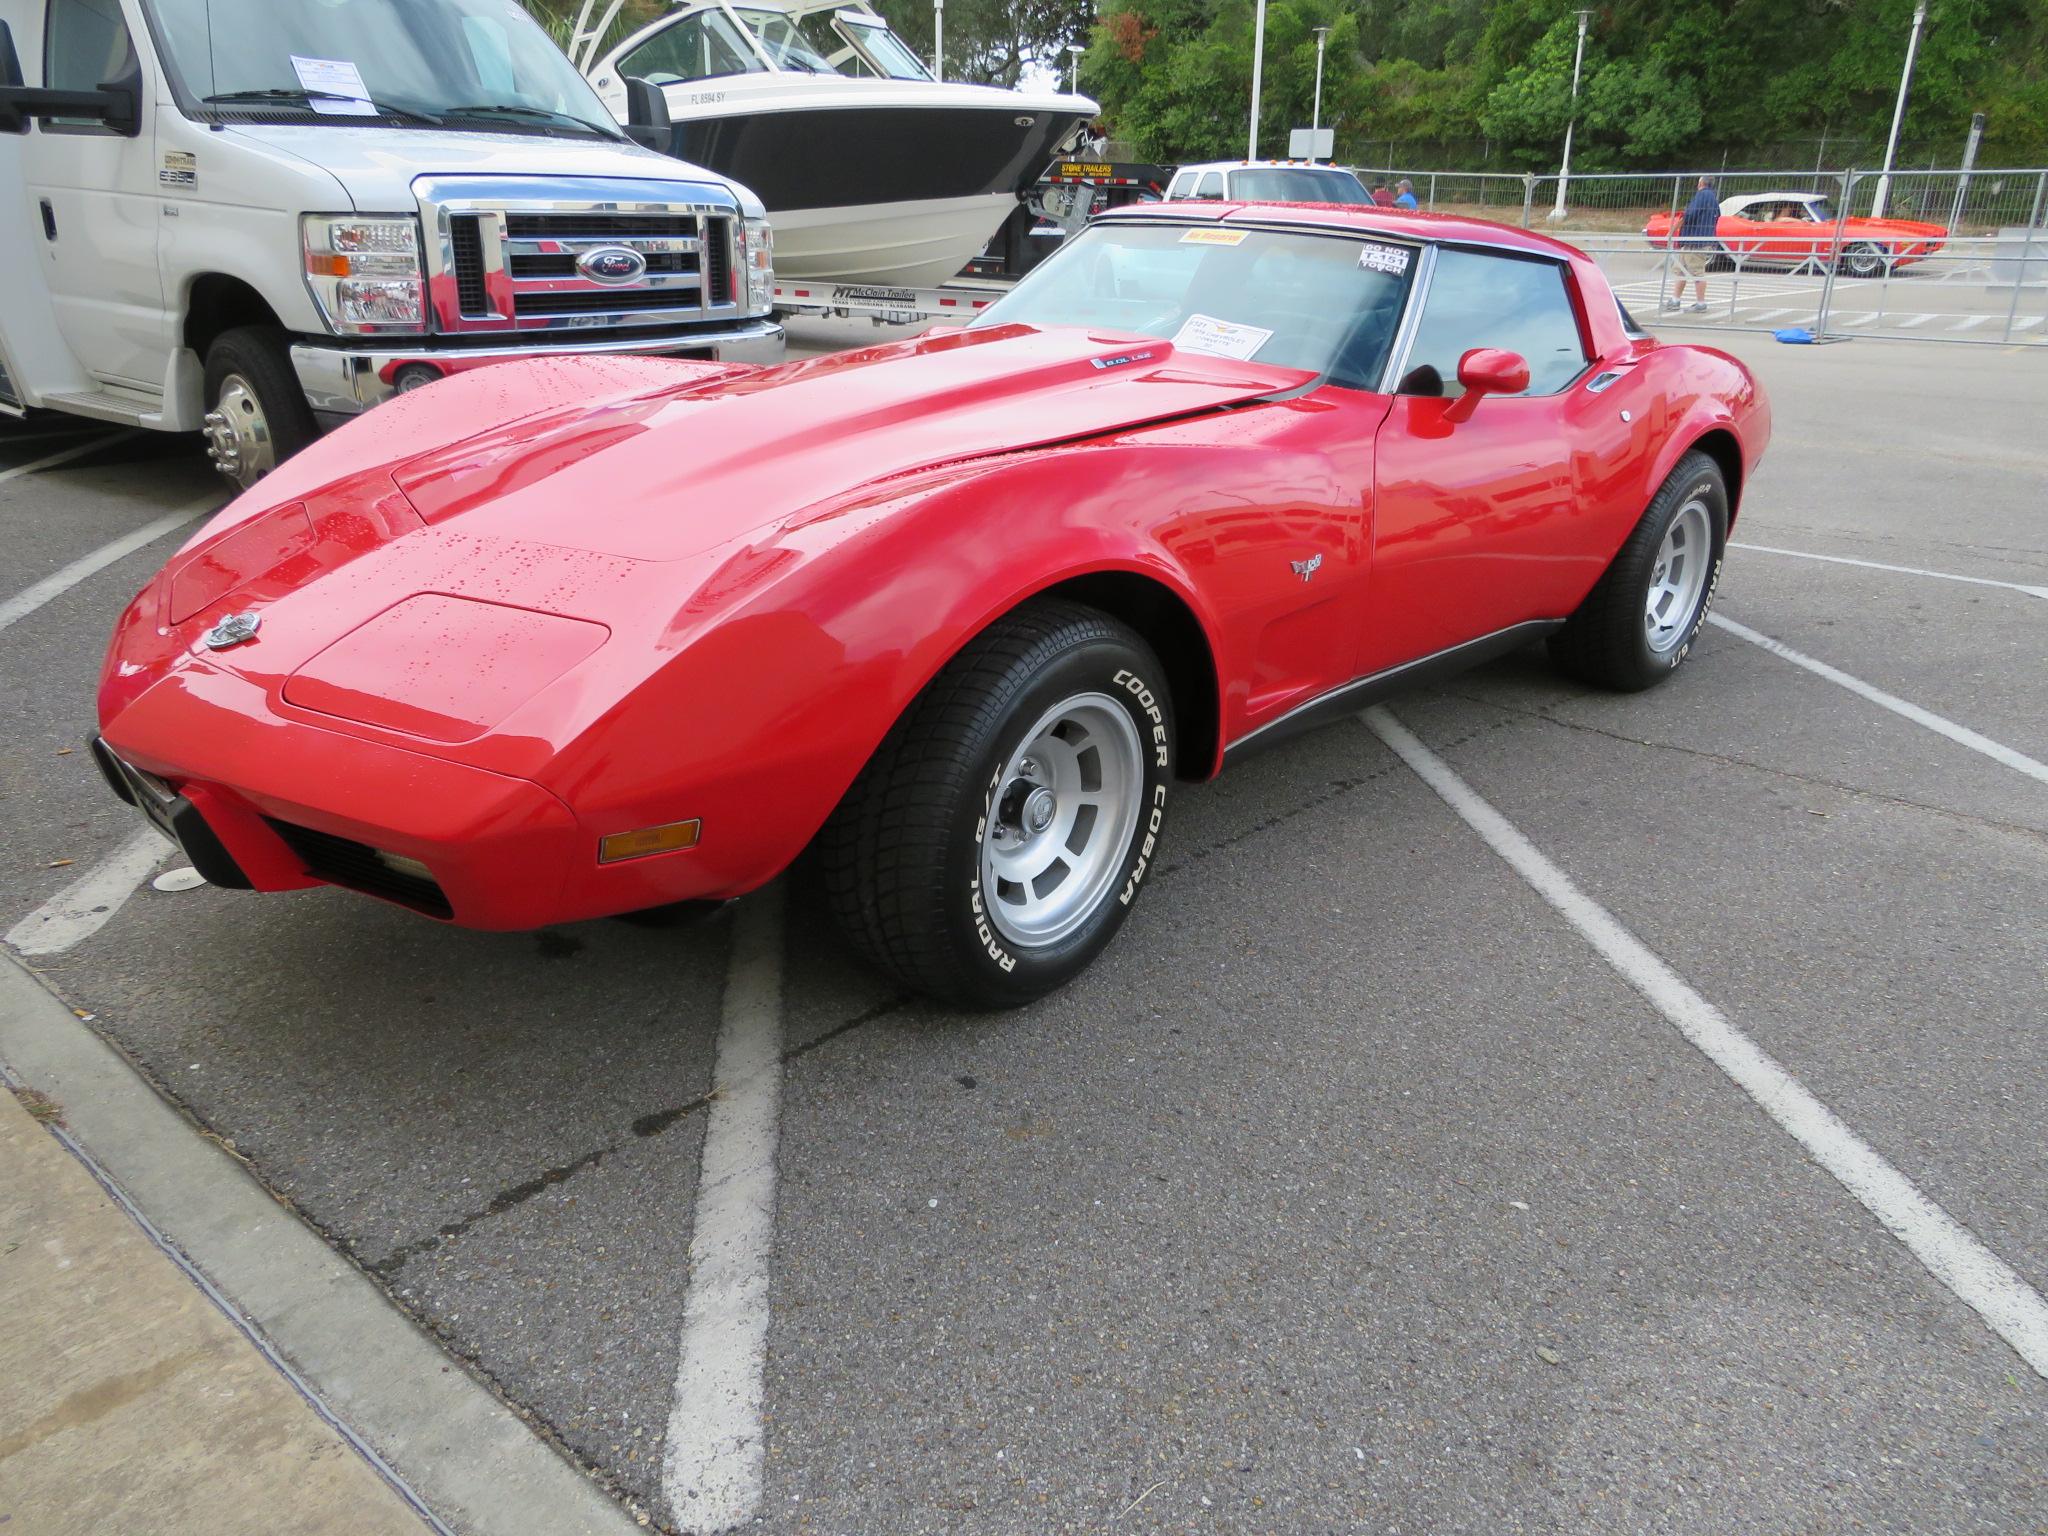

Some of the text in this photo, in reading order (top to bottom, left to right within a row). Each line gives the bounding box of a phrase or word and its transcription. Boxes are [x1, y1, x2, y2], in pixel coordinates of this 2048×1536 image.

[1061, 164, 1112, 173] STONE TRAILERS
[1365, 244, 1410, 257] DO NOT
[601, 256, 631, 273] Ford
[1364, 252, 1405, 266] T-151
[1362, 261, 1402, 274] TOUCH
[853, 287, 886, 298] McClain
[887, 289, 916, 299] Trailers
[1195, 335, 1231, 347] CORVETTE
[1206, 332, 1246, 344] CHEVROLET
[1691, 559, 1722, 636] RADIAL
[1112, 669, 1168, 905] COOPER COBRA
[970, 865, 1017, 973] RADIAL
